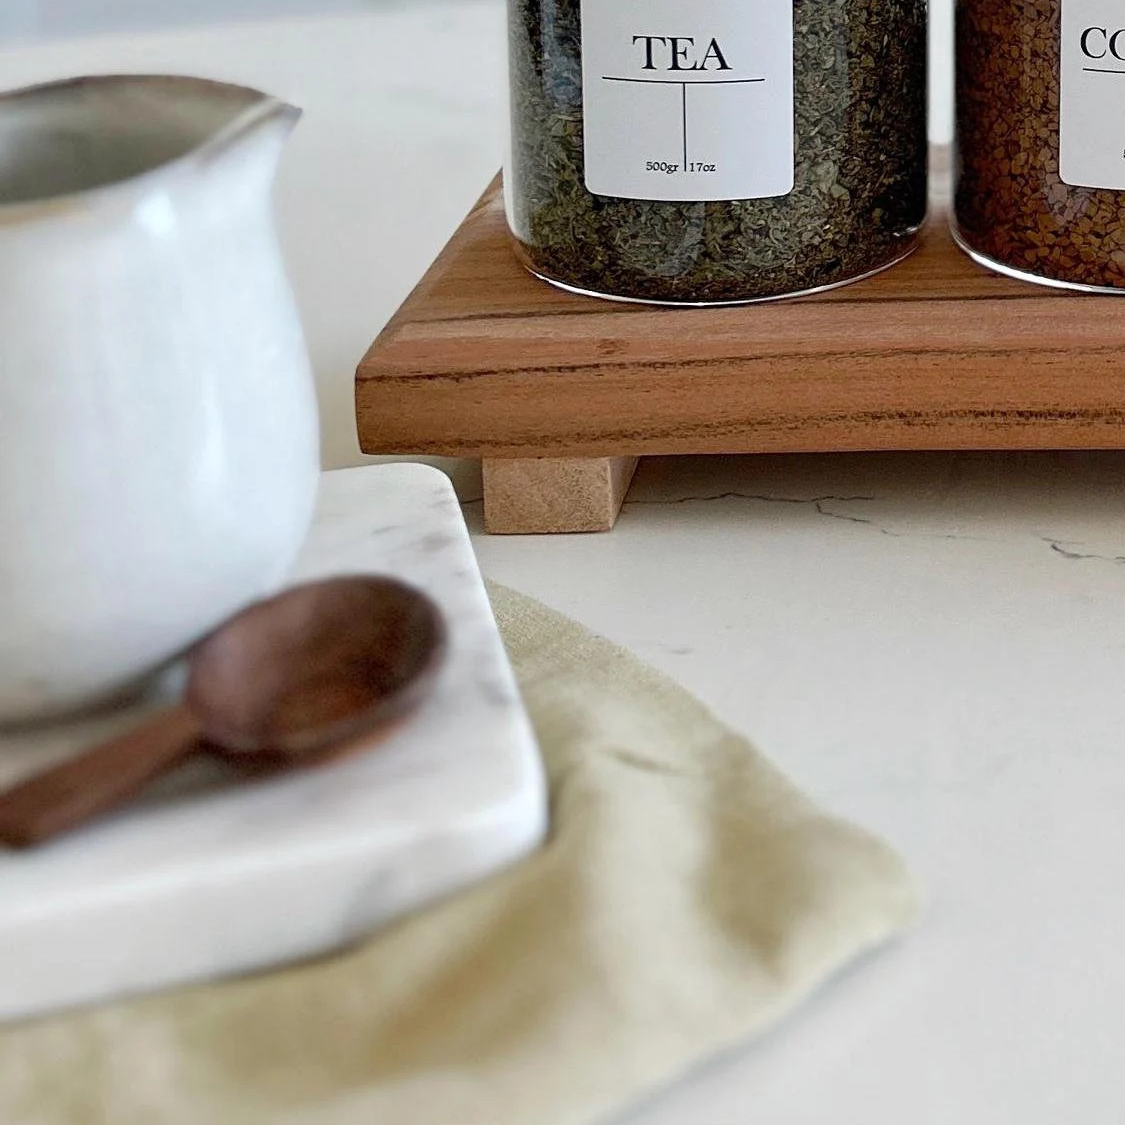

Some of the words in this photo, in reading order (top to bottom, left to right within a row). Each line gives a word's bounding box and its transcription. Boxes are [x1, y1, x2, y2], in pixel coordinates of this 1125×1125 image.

[632, 35, 733, 71] TEA
[645, 161, 679, 175] 500gr
[689, 162, 717, 173] 17oz
